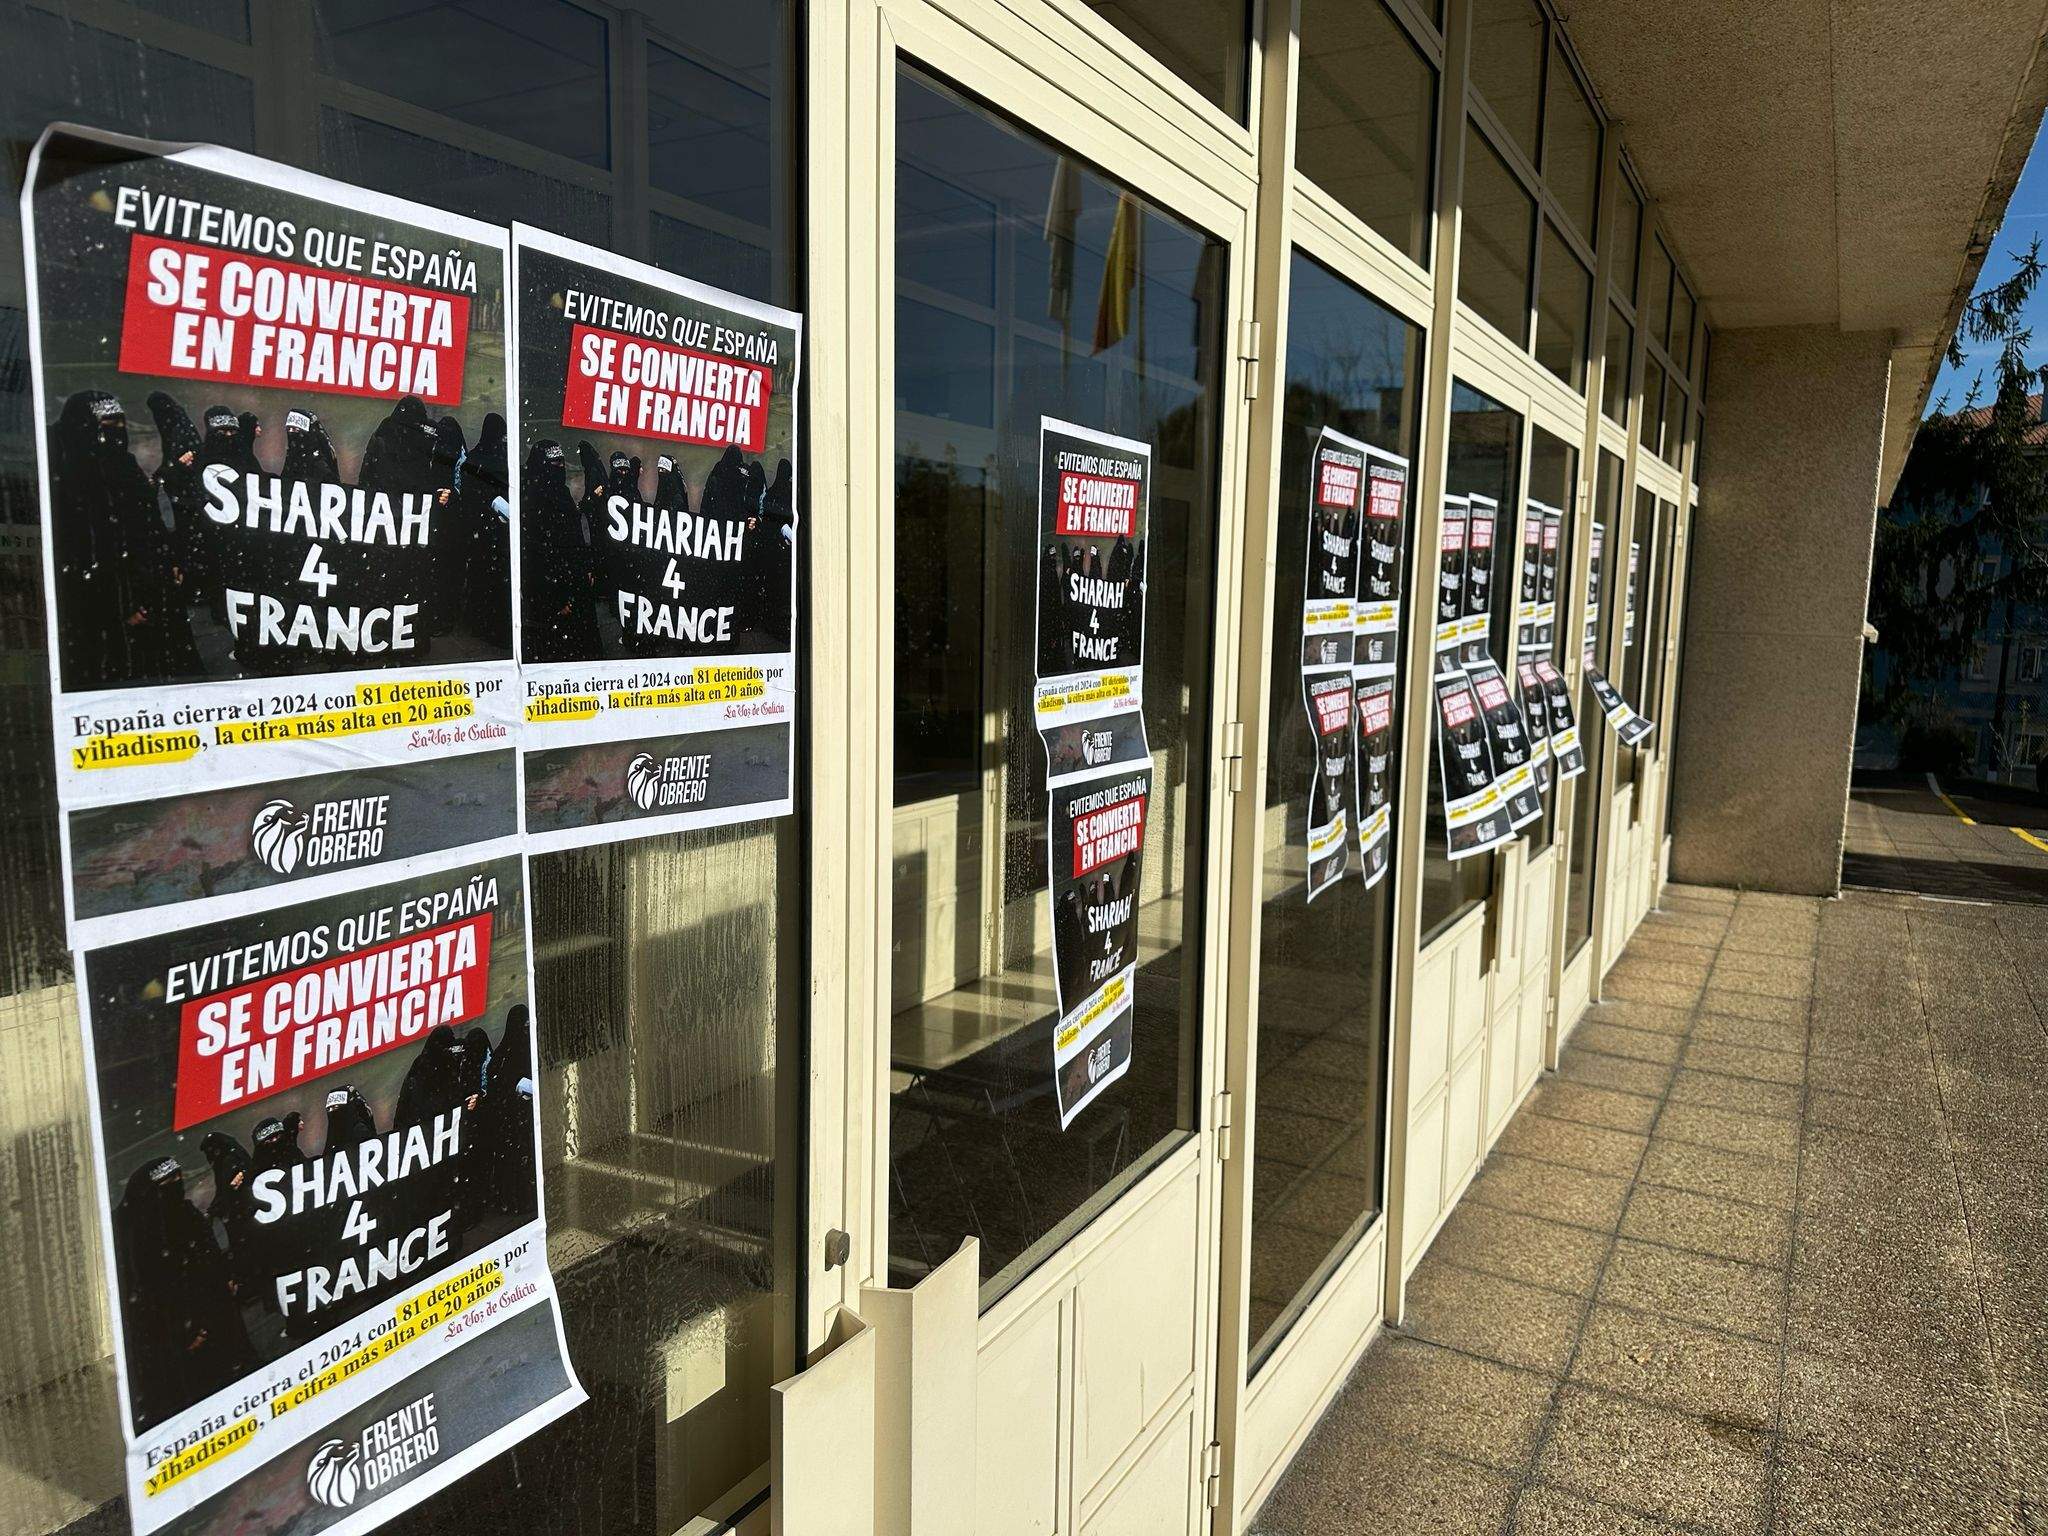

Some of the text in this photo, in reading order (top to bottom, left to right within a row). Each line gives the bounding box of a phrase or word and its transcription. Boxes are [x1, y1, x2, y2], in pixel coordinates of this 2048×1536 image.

[115, 186, 478, 293] EVITEMOS QUE ESPAÑA
[148, 247, 453, 347] SE CONVIERTA
[564, 289, 778, 365] EVITEMOS QUE ESPAÑA
[171, 313, 439, 396] EN FRANCIA
[580, 333, 763, 407] SE CONVIERTA
[592, 381, 751, 446] EN FRANCIA
[1058, 451, 1142, 480] EVITEMOS QUE ESPAÑA
[203, 464, 432, 546] SHARIAH
[1063, 476, 1134, 509] SE CONVIERTA
[607, 494, 745, 562] SHARIAH
[1066, 505, 1130, 534] EN FRANCIA
[299, 544, 337, 597] 4
[662, 558, 685, 599] 4
[1070, 573, 1124, 609] SHARIAH
[227, 588, 418, 652] FRANCE
[618, 589, 734, 643] FRANCE
[1089, 609, 1100, 635] 4
[1072, 631, 1119, 662] FRANCE
[526, 683, 764, 721] yihadismo, la cifra más alta en 20 años
[527, 666, 784, 699] España cierra el 2024 con 81 detenidos por
[73, 678, 503, 739] España cierra el 2024 con 81 detenidos por
[752, 703, 760, 714] de
[760, 700, 785, 715] Galicia
[75, 701, 471, 769] yihadismo, la cifra más alta en 20 años
[454, 726, 466, 743] de
[468, 722, 507, 740] Galicia
[663, 754, 711, 780] FRENTE
[311, 795, 390, 835] FRENTE
[659, 778, 707, 806] OBRERO
[1069, 775, 1147, 819] EVITEMOS QUE ESPAÑA
[1076, 801, 1142, 846] SE CONVIERTA
[306, 827, 385, 867] OBRERO
[1082, 825, 1138, 871] EN FRANCIA
[1087, 893, 1133, 933] SHARIAH
[165, 874, 499, 1004] EVITEMOS QUE ESPAÑA
[1104, 931, 1112, 955] 4
[1089, 946, 1124, 982] FRANCE
[197, 924, 477, 1057] SE CONVIERTA
[220, 976, 465, 1105] EN FRANCIA
[252, 1106, 462, 1223] SHARIAH
[342, 1200, 377, 1246] 4
[276, 1210, 453, 1317] FRANCE
[486, 1301, 498, 1316] de
[499, 1281, 537, 1310] Galicia
[145, 1240, 530, 1471] España cierra el 2024 con 81 detenidos por
[148, 1275, 501, 1497] yihadismo, la cifra más alta en 20 años
[361, 1393, 437, 1458] FRENTE
[363, 1425, 439, 1491] OBRERO
